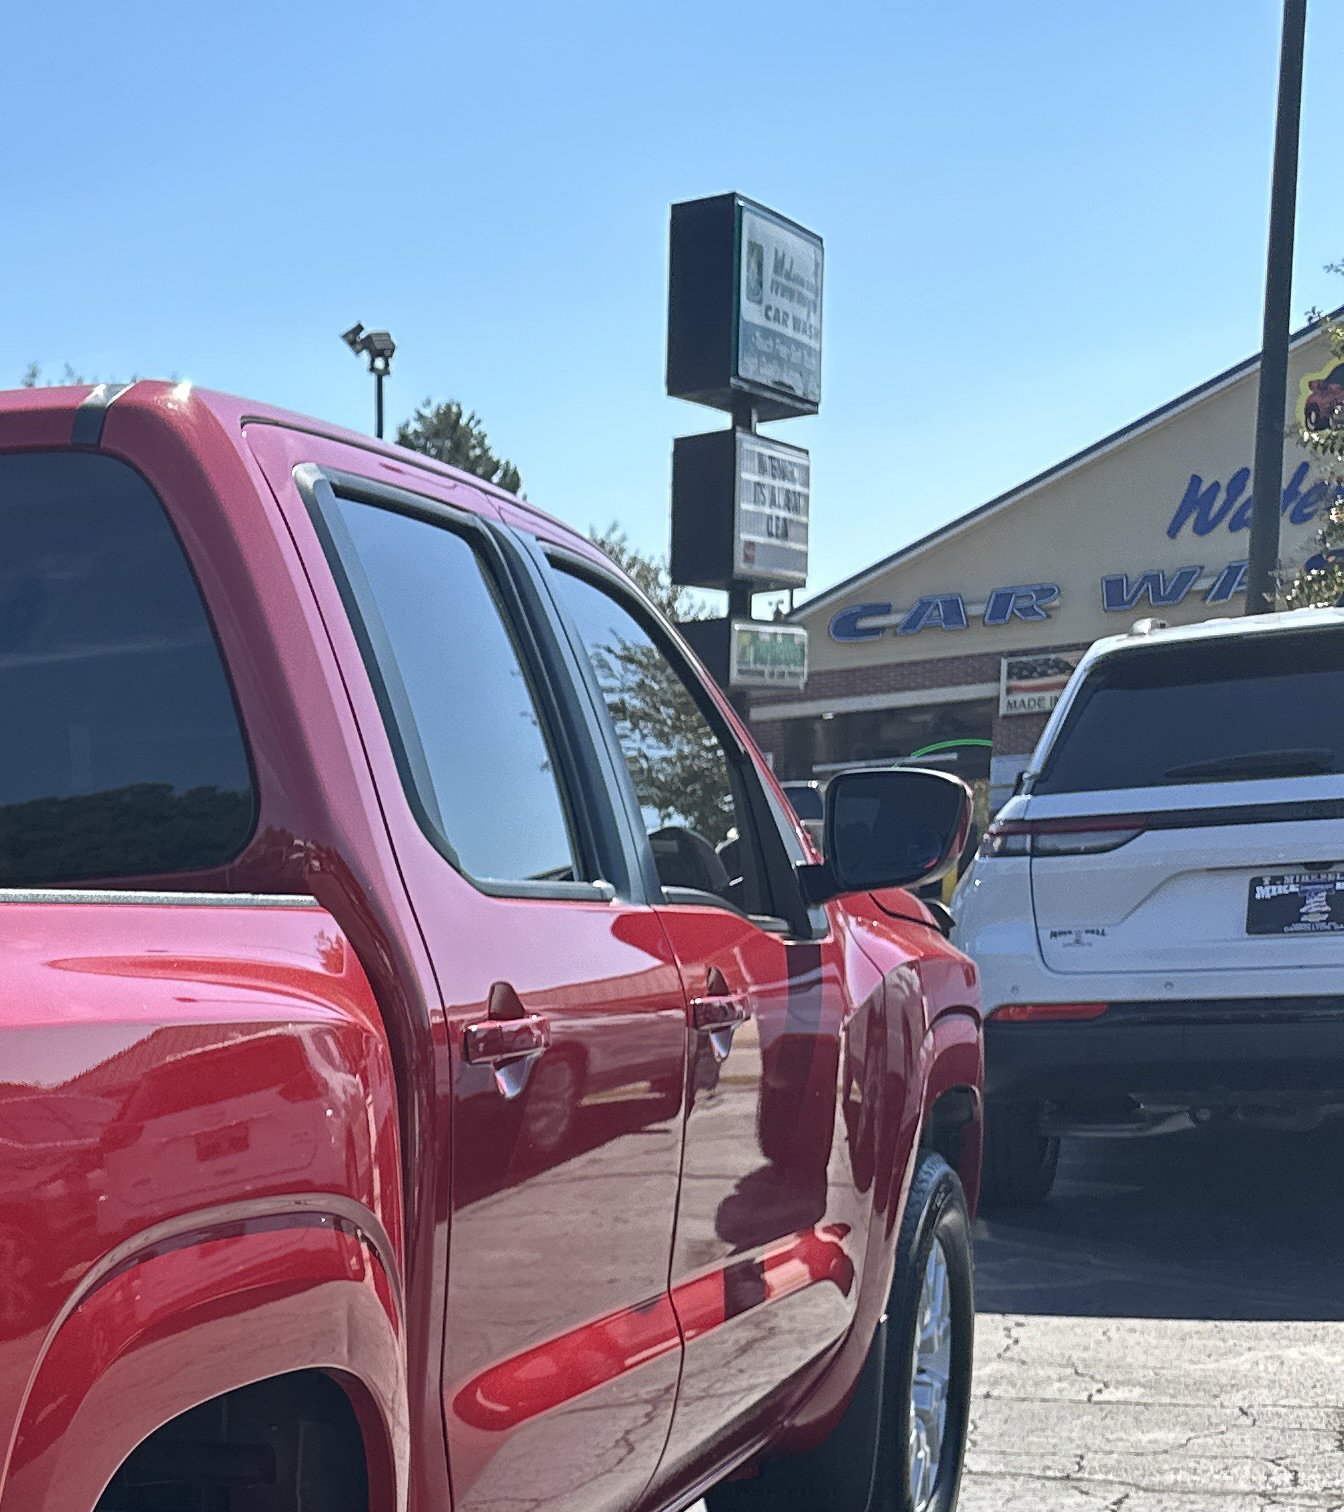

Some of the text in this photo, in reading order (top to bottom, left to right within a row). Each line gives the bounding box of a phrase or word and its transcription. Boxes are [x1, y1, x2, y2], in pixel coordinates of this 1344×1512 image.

[764, 303, 790, 328] CAR
[828, 582, 1061, 643] CAR
[1006, 696, 1046, 712] MADE
